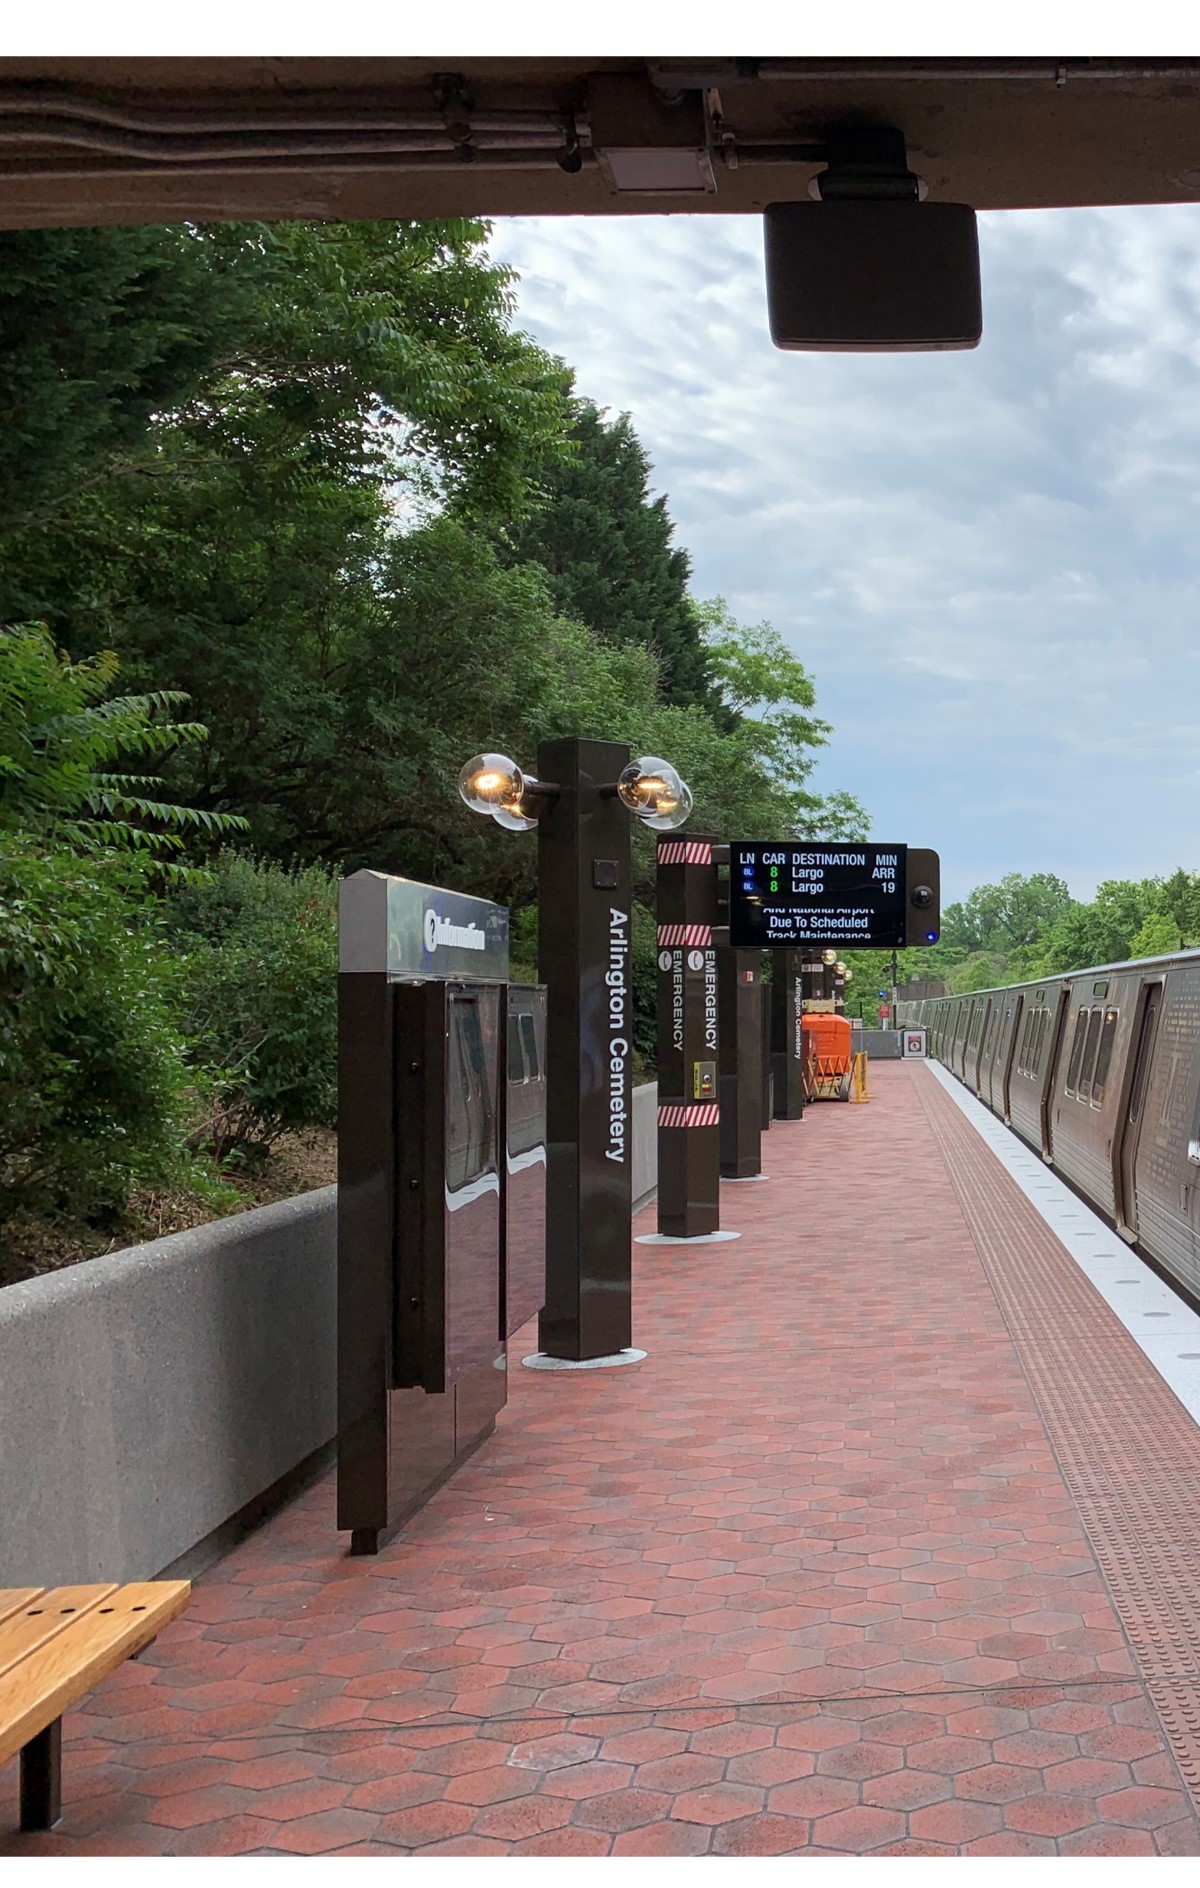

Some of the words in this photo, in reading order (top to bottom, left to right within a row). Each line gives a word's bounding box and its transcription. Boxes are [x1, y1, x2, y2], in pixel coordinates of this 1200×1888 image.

[740, 853, 755, 864] LN
[763, 853, 785, 864] CAR
[792, 854, 865, 866] DESTINATION
[876, 855, 897, 866] MIN
[744, 882, 753, 890] BL
[770, 881, 778, 892] 8
[792, 881, 824, 894] Largo
[882, 882, 895, 893] 19
[770, 867, 778, 878] 8
[792, 867, 824, 880] Largo
[872, 868, 895, 878] ARR
[770, 916, 792, 928] Due
[794, 917, 807, 928] To
[810, 917, 868, 928] Scheduled
[605, 908, 628, 1029] Arlington
[673, 950, 683, 1051] EMERGENCY
[705, 950, 716, 1050] EMERGENCY
[605, 1038, 628, 1163] Cemetery
